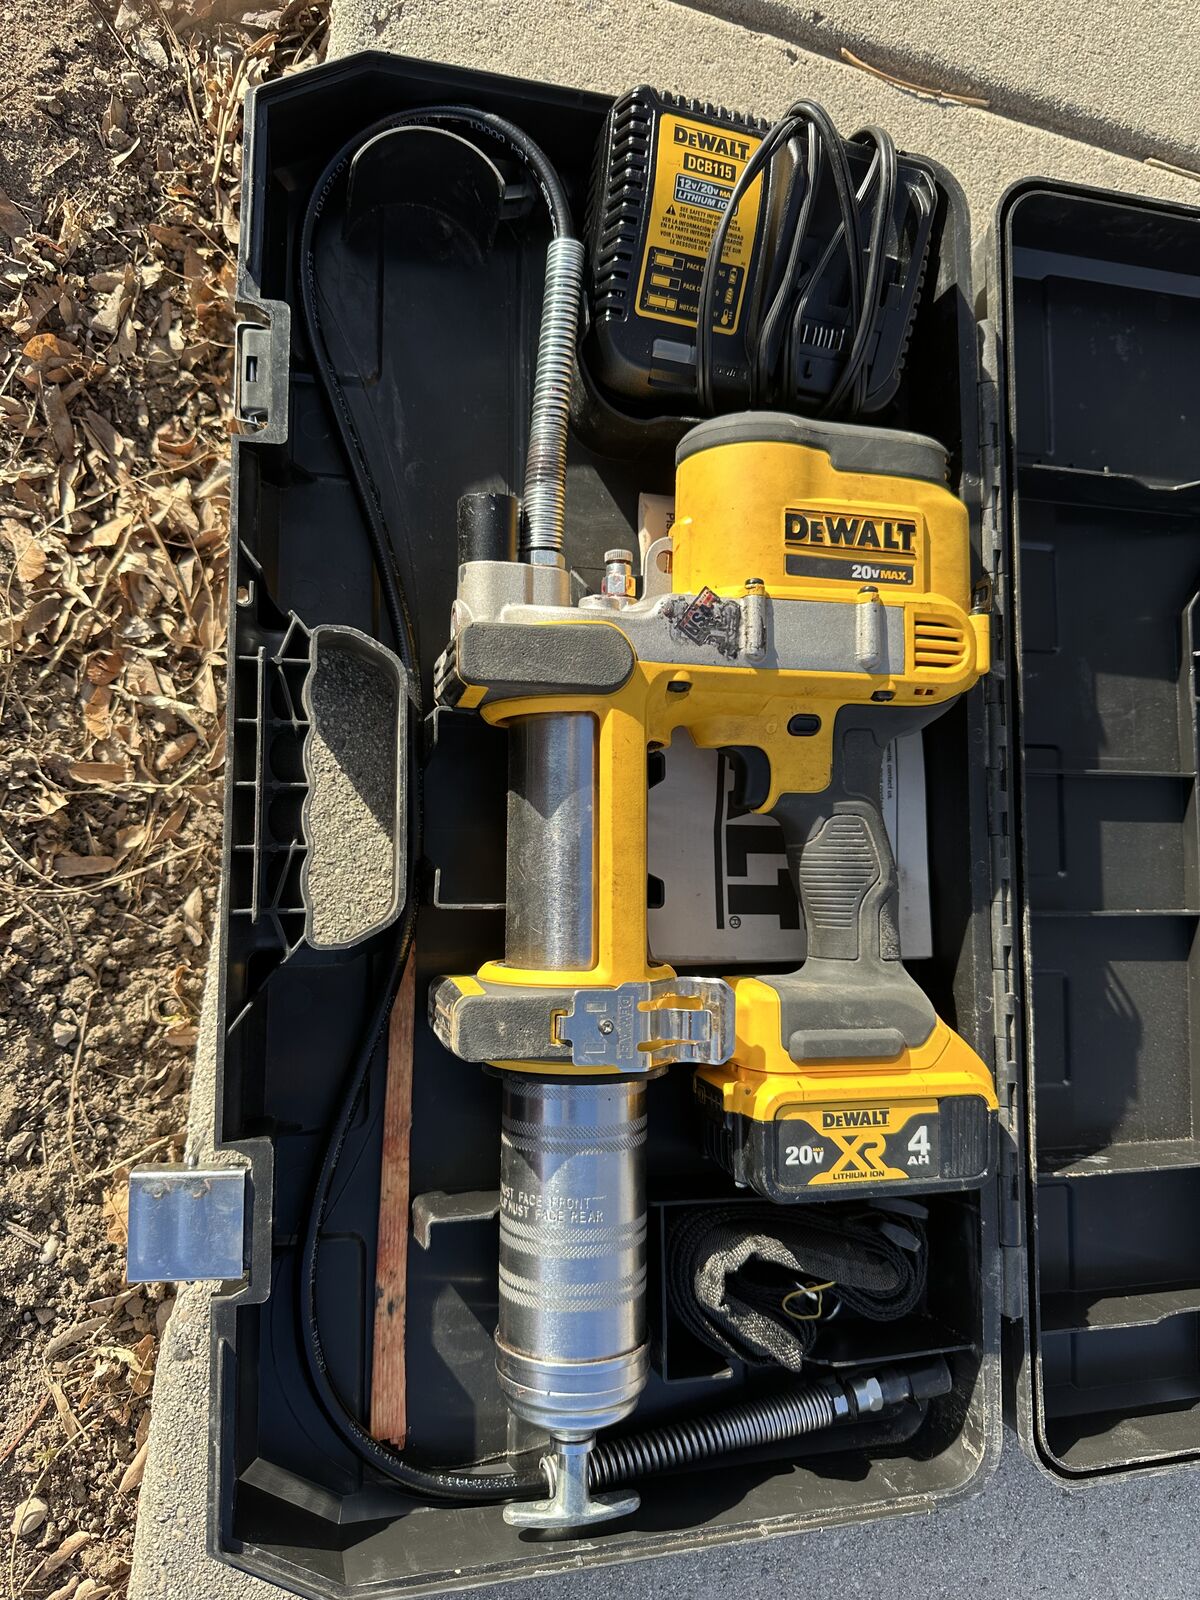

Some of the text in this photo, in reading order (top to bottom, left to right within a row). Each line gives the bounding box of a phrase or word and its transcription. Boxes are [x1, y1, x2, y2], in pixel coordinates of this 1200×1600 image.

[674, 126, 750, 160] DEWALT
[687, 155, 732, 180] DCB115
[677, 191, 728, 210] LITHIUM IO
[719, 189, 731, 199] MA
[688, 208, 706, 217] SAFETY
[785, 512, 916, 551] DEWALT
[880, 570, 906, 580] MAX
[822, 1109, 889, 1128] DEWALT
[907, 1125, 931, 1156] 4
[785, 1145, 824, 1166] 20V
[826, 1133, 889, 1171] XR
[907, 1154, 930, 1166] AH
[833, 1170, 885, 1180] LITHIUM ION
[518, 1191, 543, 1208] FACE
